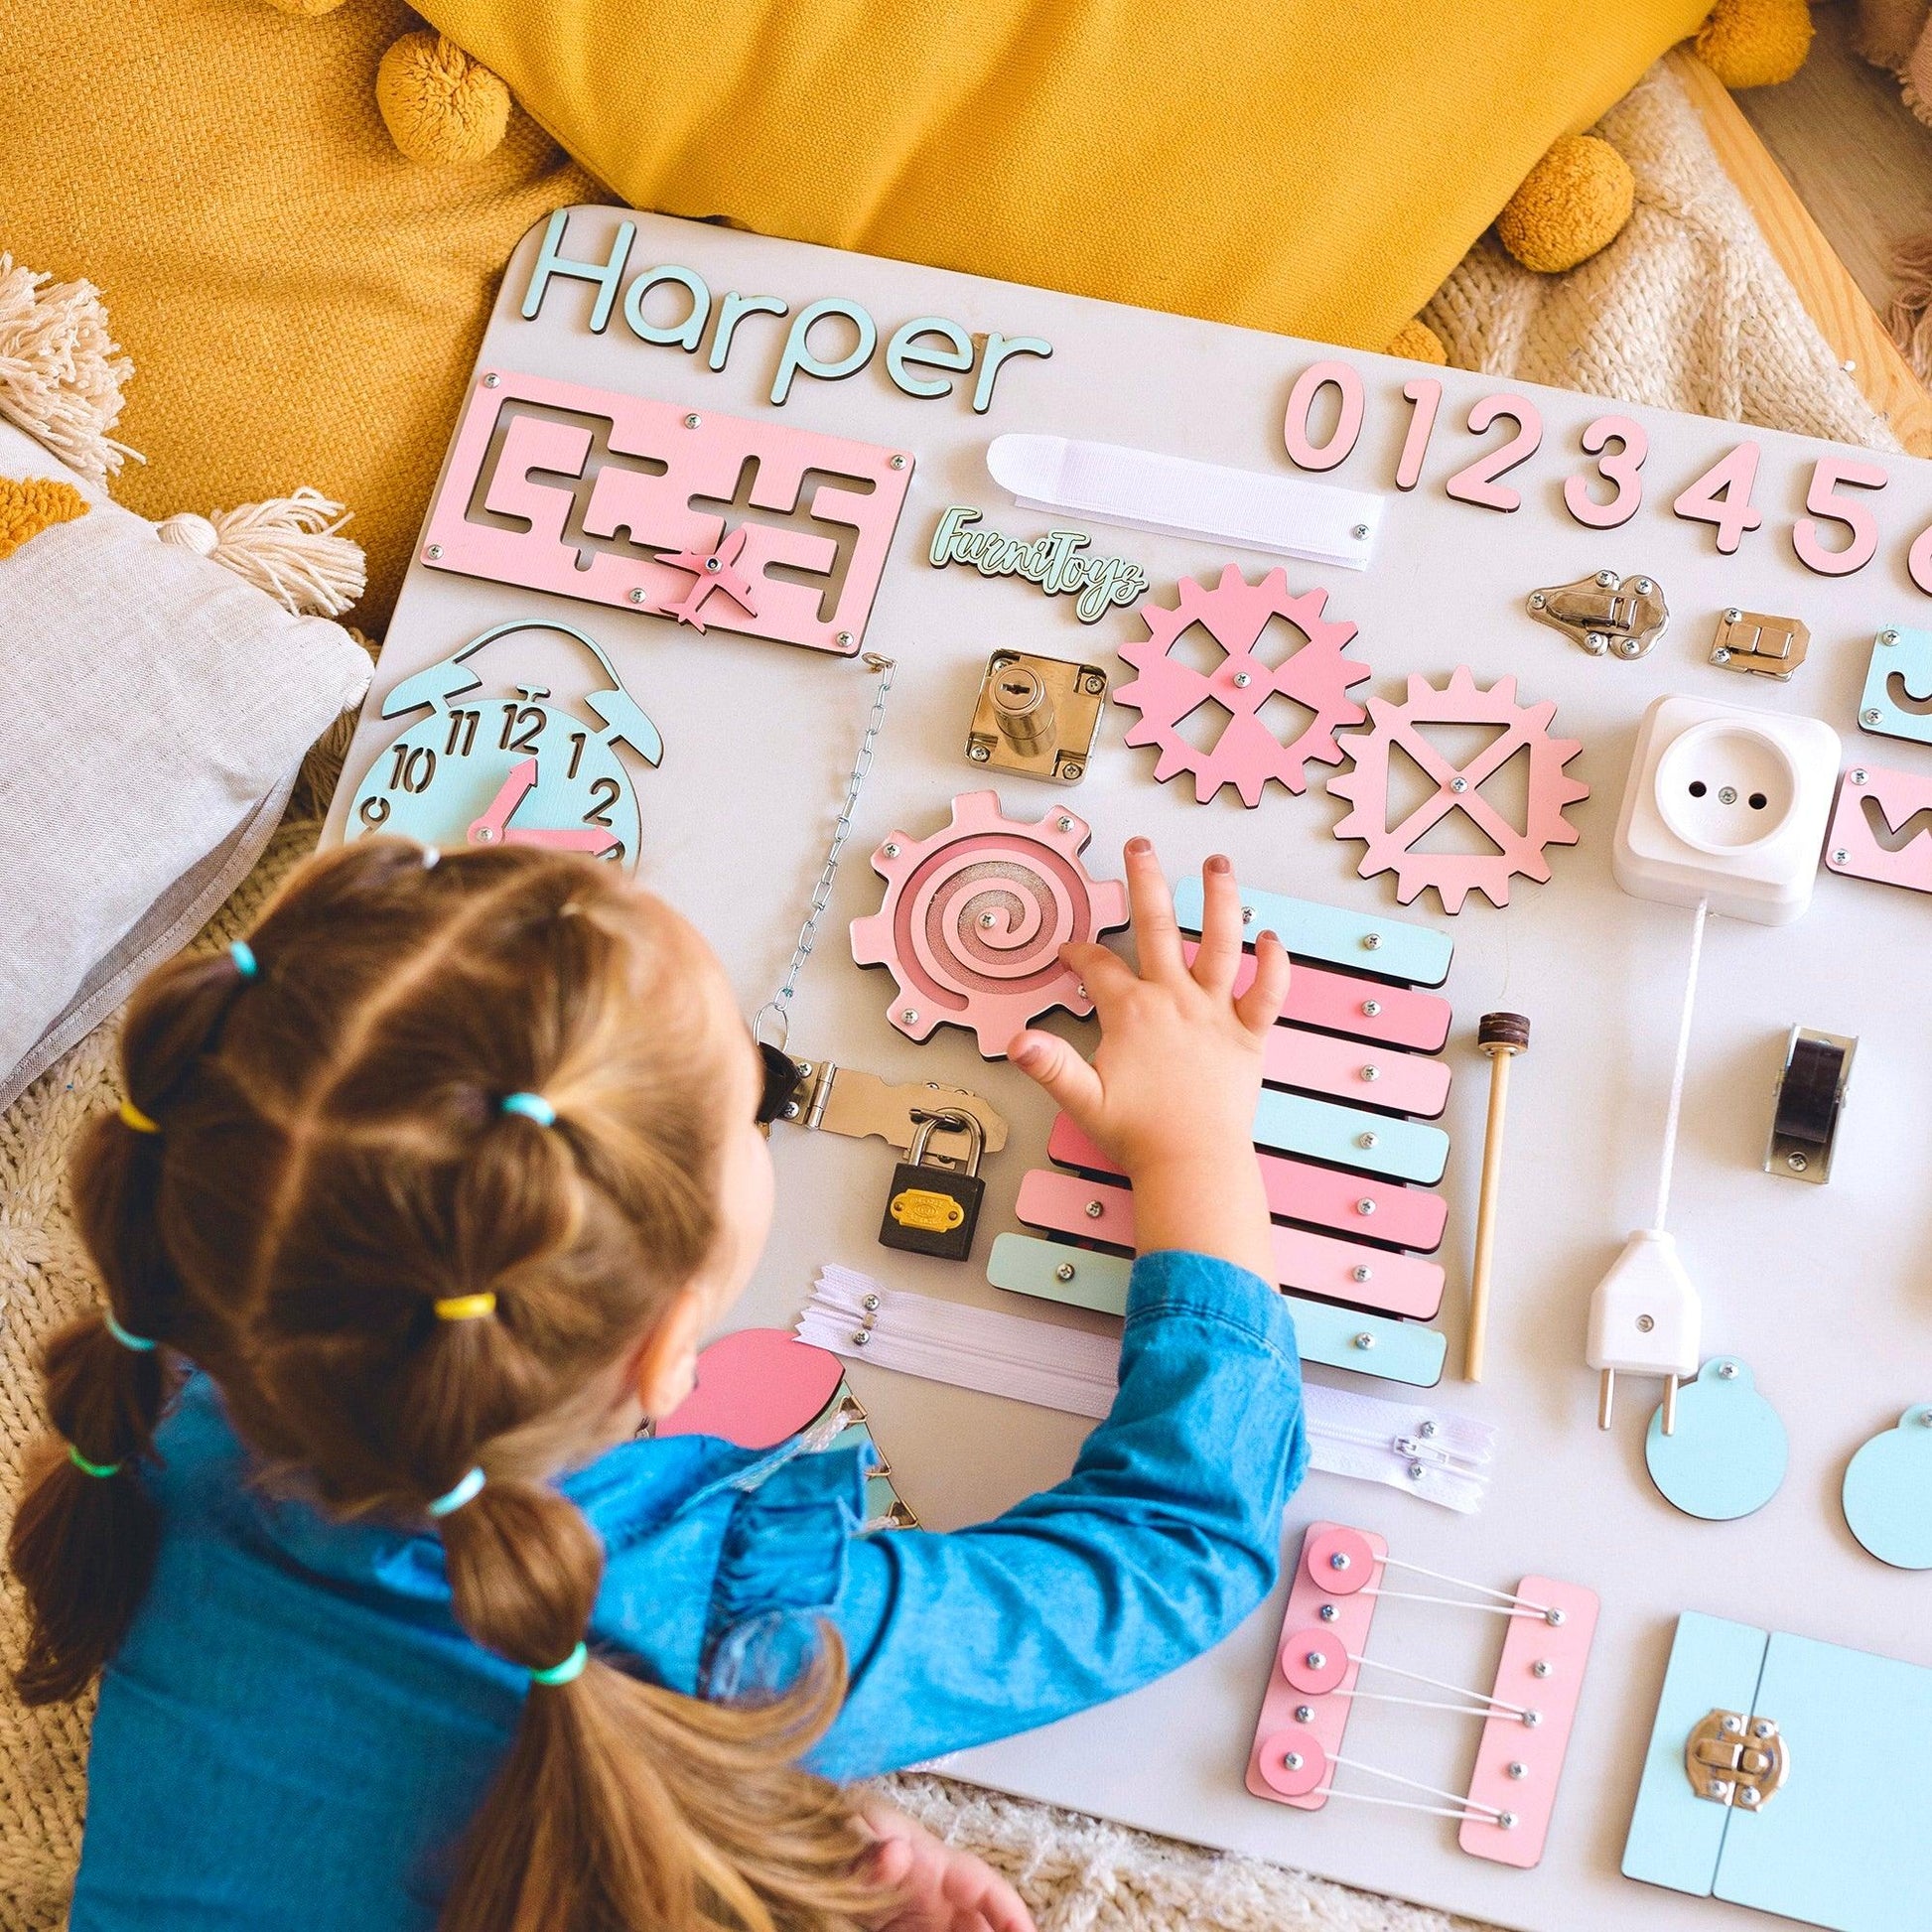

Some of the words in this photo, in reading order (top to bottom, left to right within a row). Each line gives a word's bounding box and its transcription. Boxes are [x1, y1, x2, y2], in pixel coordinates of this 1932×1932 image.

[521, 208, 1052, 414] Harper
[929, 504, 1150, 624] FurniToys
[445, 709, 481, 757] 11
[498, 703, 547, 756] 12
[389, 744, 436, 793] 10
[567, 732, 587, 779] 1
[582, 776, 621, 827] 2
